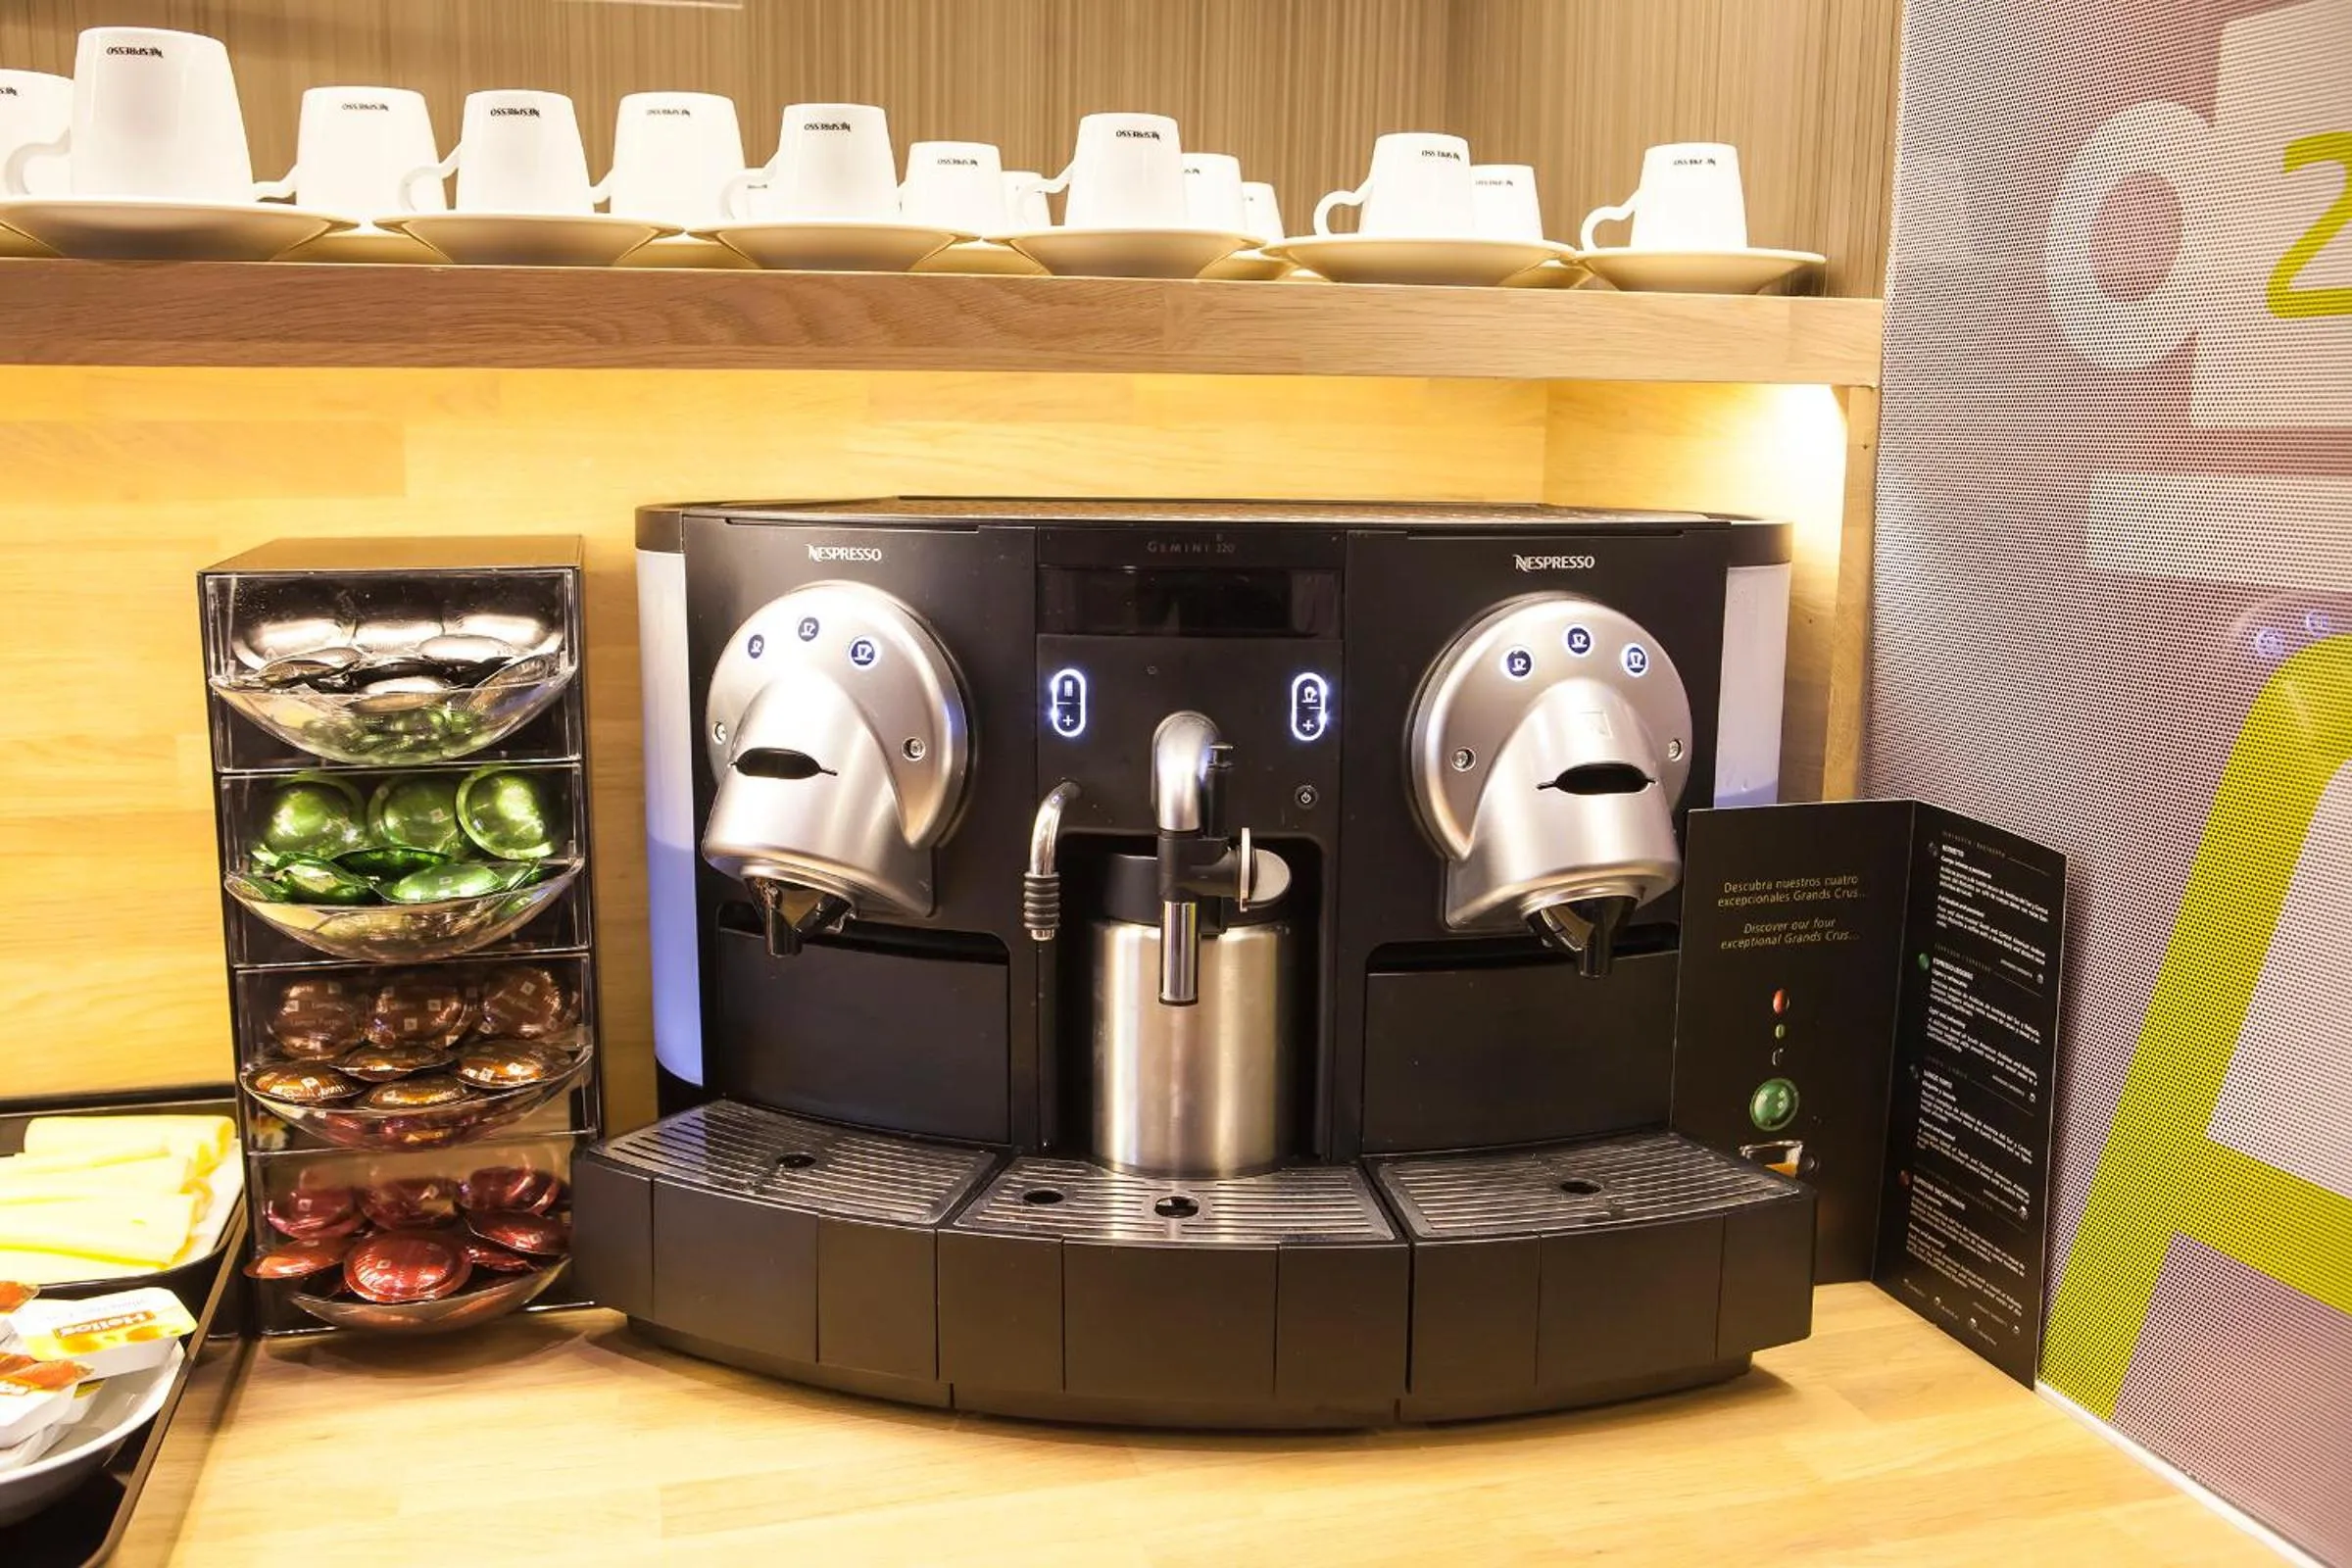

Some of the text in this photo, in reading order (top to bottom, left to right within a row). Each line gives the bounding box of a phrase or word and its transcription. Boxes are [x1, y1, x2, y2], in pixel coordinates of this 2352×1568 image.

[105, 46, 164, 59] NESPRESSO
[804, 122, 852, 132] NESPRESSO
[805, 543, 883, 563] NESPRESSO
[1512, 554, 1595, 572] NESPRESSO
[1724, 875, 1859, 893] Descubra nuestros cuatro
[1717, 892, 1790, 907] excepcionales
[1793, 888, 1831, 902] Grands
[1743, 917, 1837, 935] Discover our four
[1720, 934, 1782, 950] exceptional
[1784, 931, 1822, 945] Grands
[60, 1311, 147, 1338] Helios
